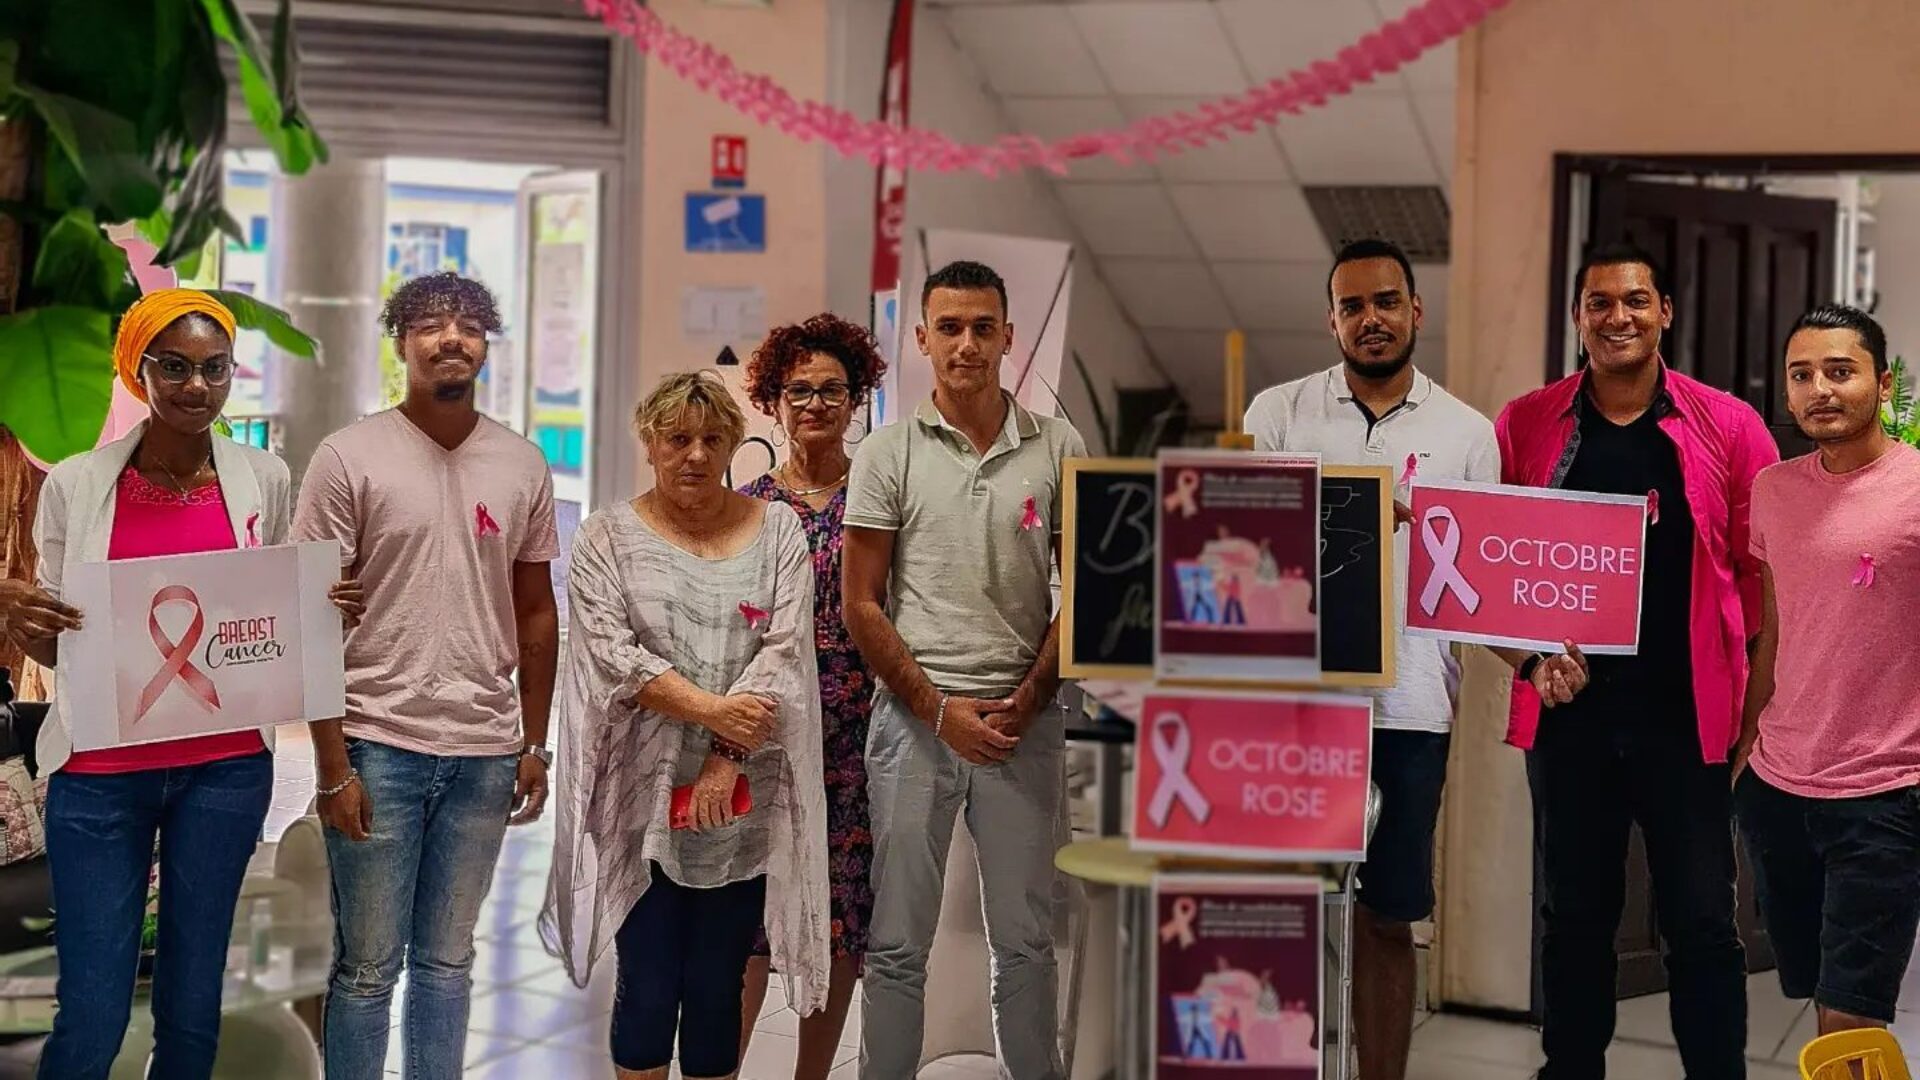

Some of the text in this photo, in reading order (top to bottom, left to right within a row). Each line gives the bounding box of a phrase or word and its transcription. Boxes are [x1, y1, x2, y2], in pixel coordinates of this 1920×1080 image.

[1480, 536, 1635, 574] OCTOBRE
[1513, 578, 1597, 612] ROSE
[218, 616, 276, 645] BREAST
[205, 634, 286, 669] Cancer
[1208, 738, 1363, 778] OCTOBRE
[1241, 781, 1327, 818] ROSE
